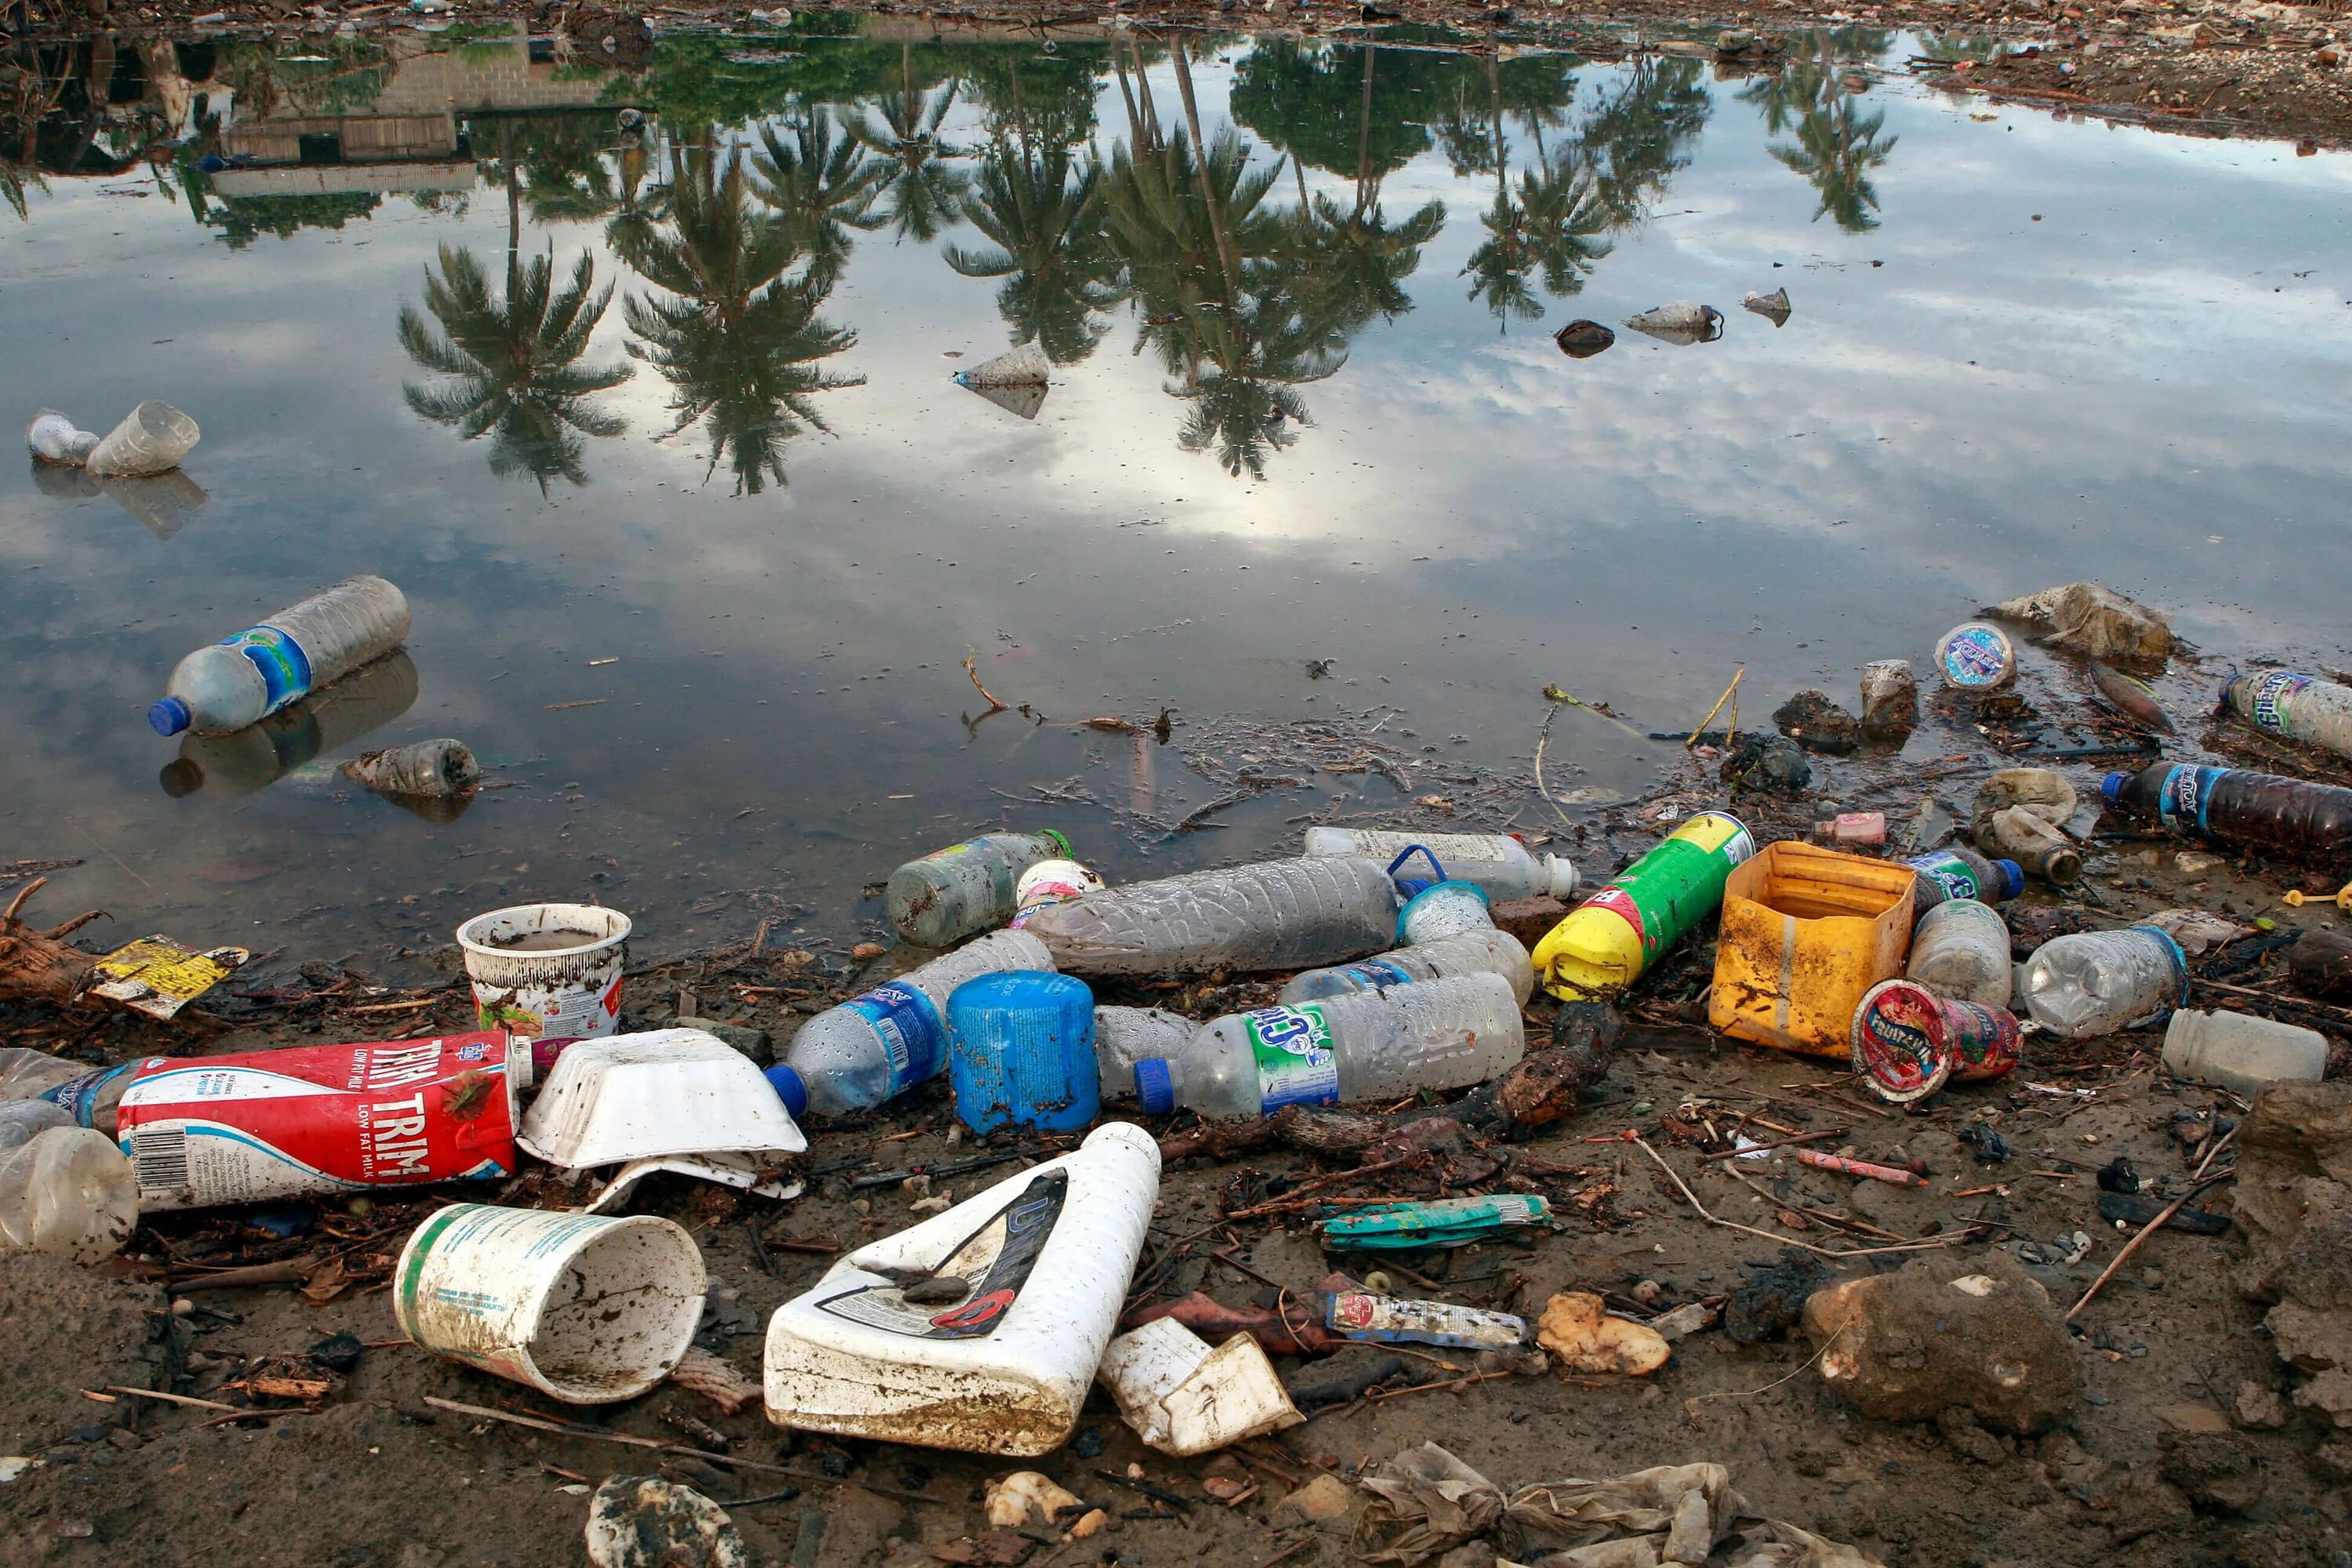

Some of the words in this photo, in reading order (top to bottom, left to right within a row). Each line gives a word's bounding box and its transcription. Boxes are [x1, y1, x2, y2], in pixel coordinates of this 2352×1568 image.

[2256, 673, 2288, 727] Cheers
[354, 1048, 368, 1063] LOW
[366, 1039, 443, 1090] TRIM
[347, 1075, 365, 1089] MILK
[351, 1062, 365, 1078] FAT
[358, 1104, 369, 1129] LOW
[359, 1133, 371, 1151] FAT
[372, 1091, 430, 1178] TRIM
[362, 1154, 374, 1178] MILK
